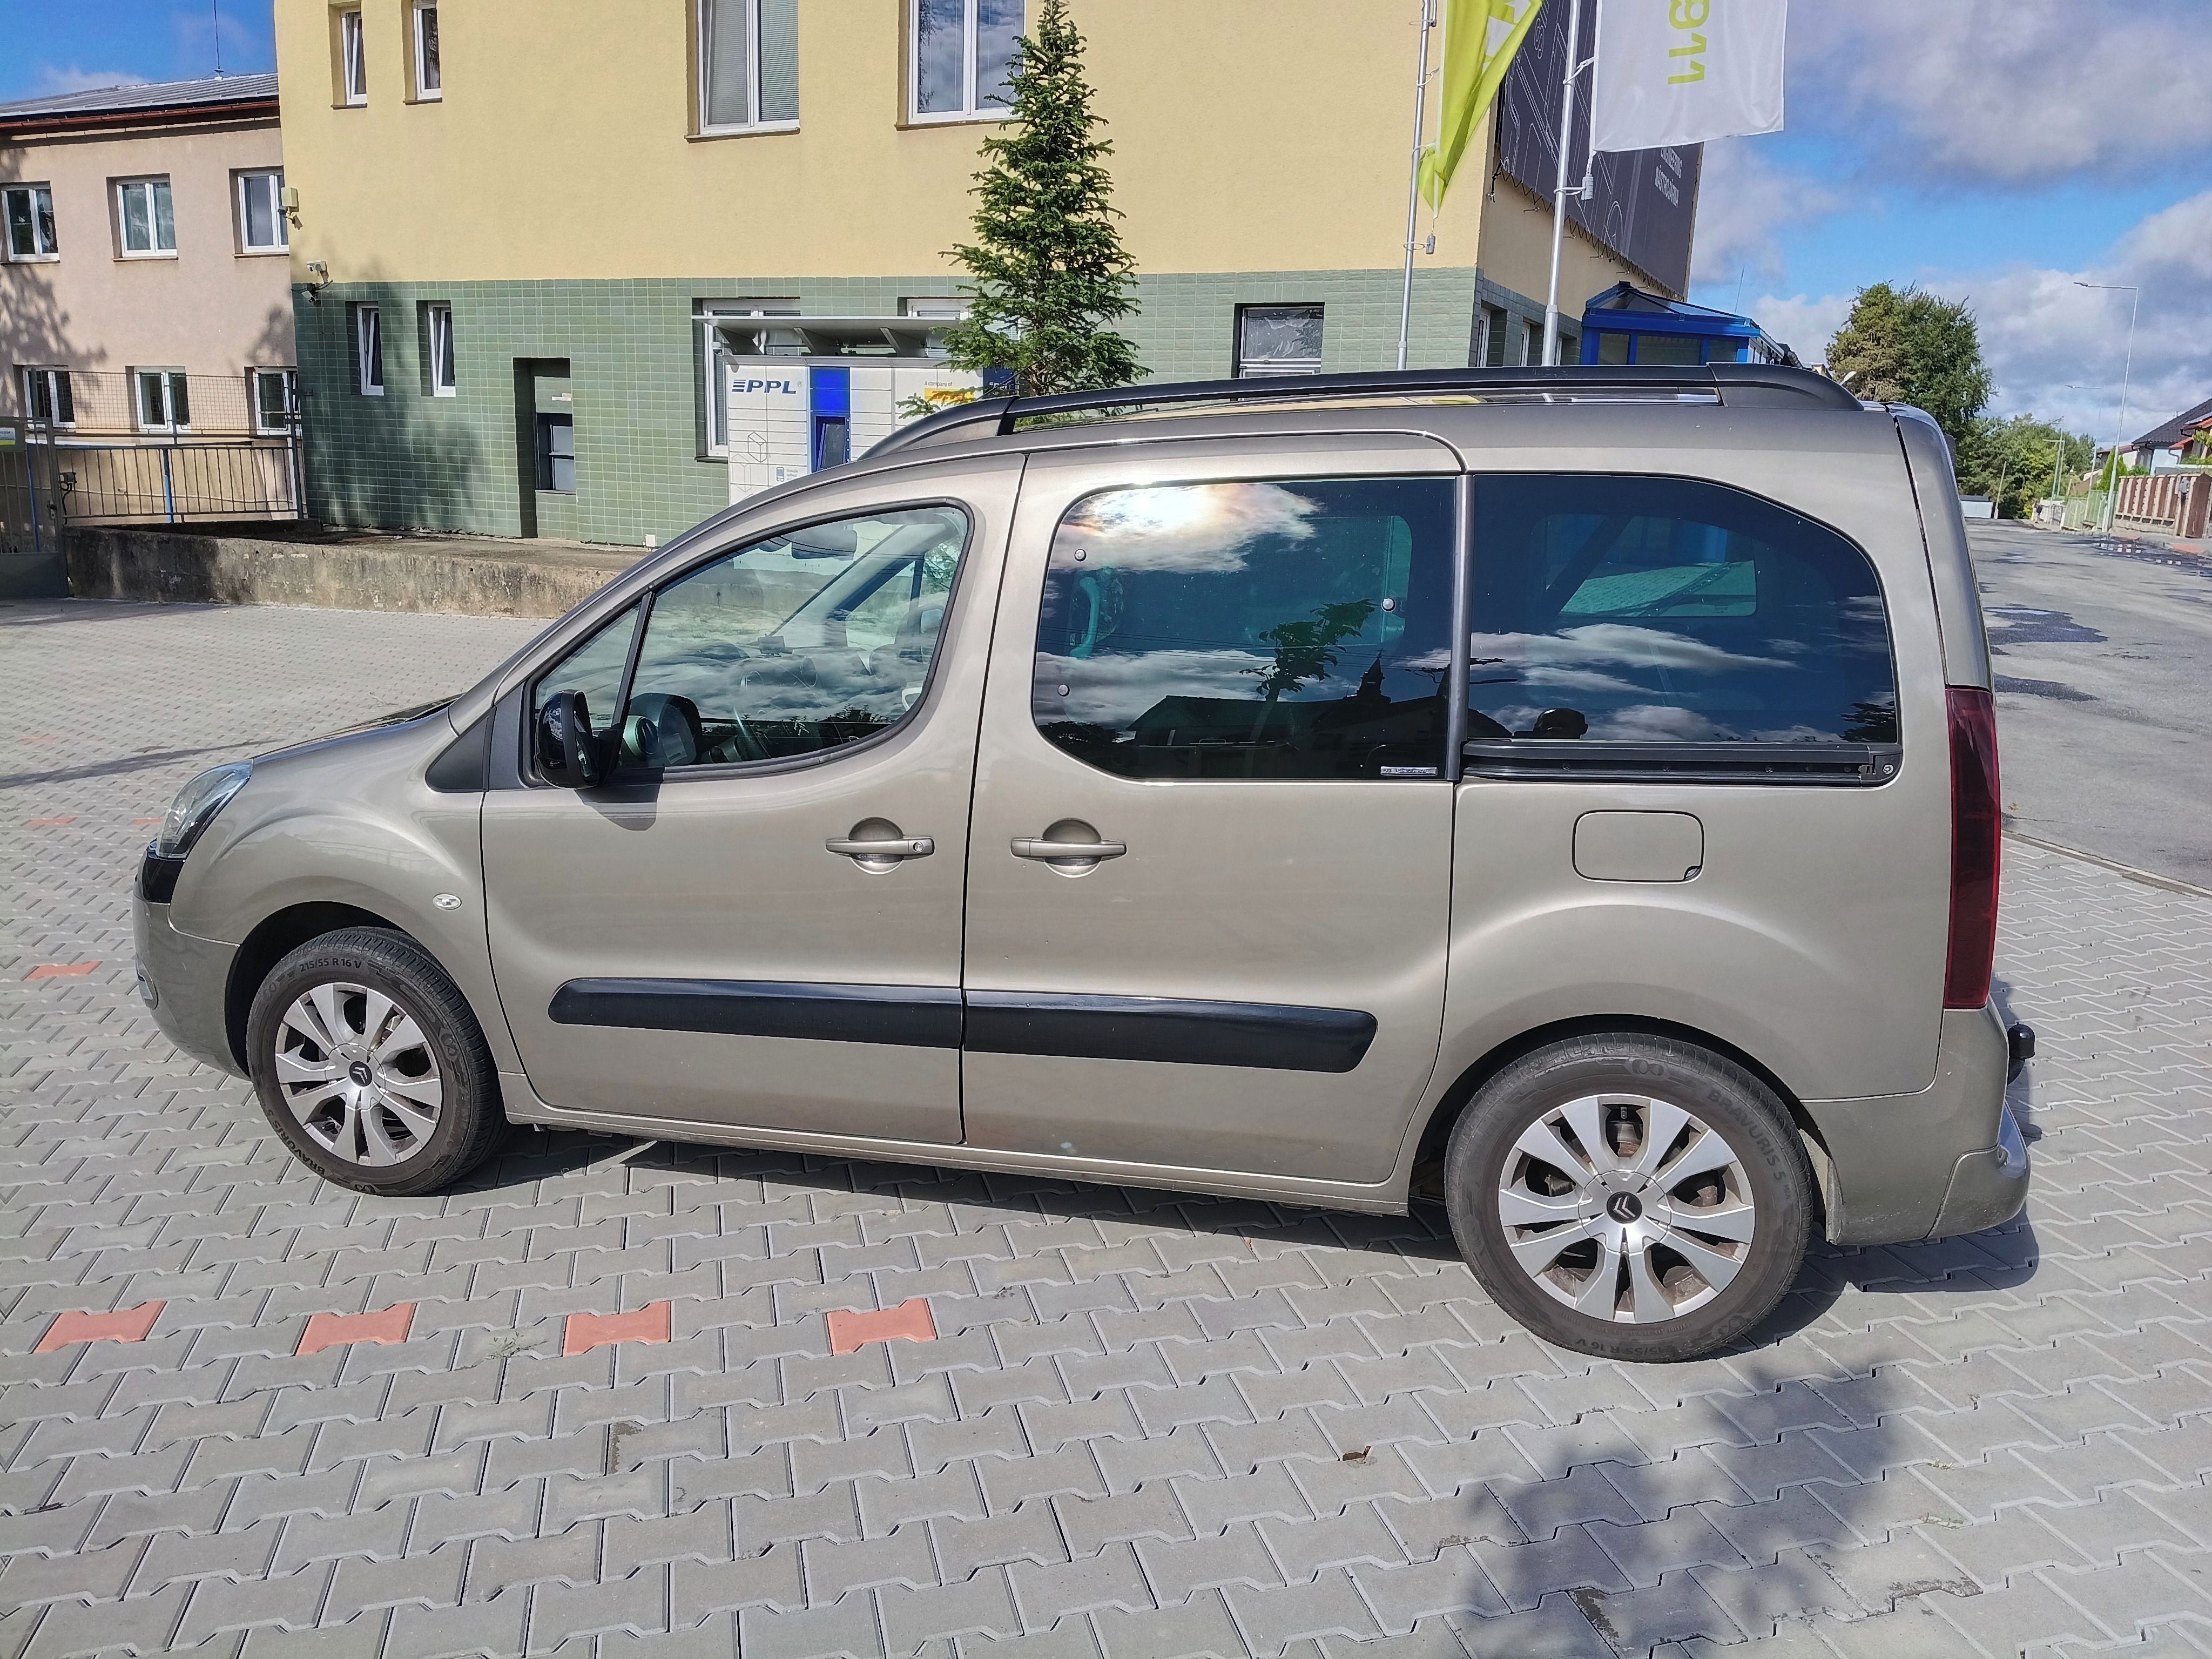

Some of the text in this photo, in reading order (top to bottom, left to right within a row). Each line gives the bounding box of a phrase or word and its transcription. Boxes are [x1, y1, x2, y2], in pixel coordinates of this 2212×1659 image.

[746, 380, 797, 394] PPL
[299, 957, 362, 972] 215/55 R 16 V
[1707, 1088, 1781, 1166] BRAVURIS
[272, 1120, 326, 1176] BRAVURIS
